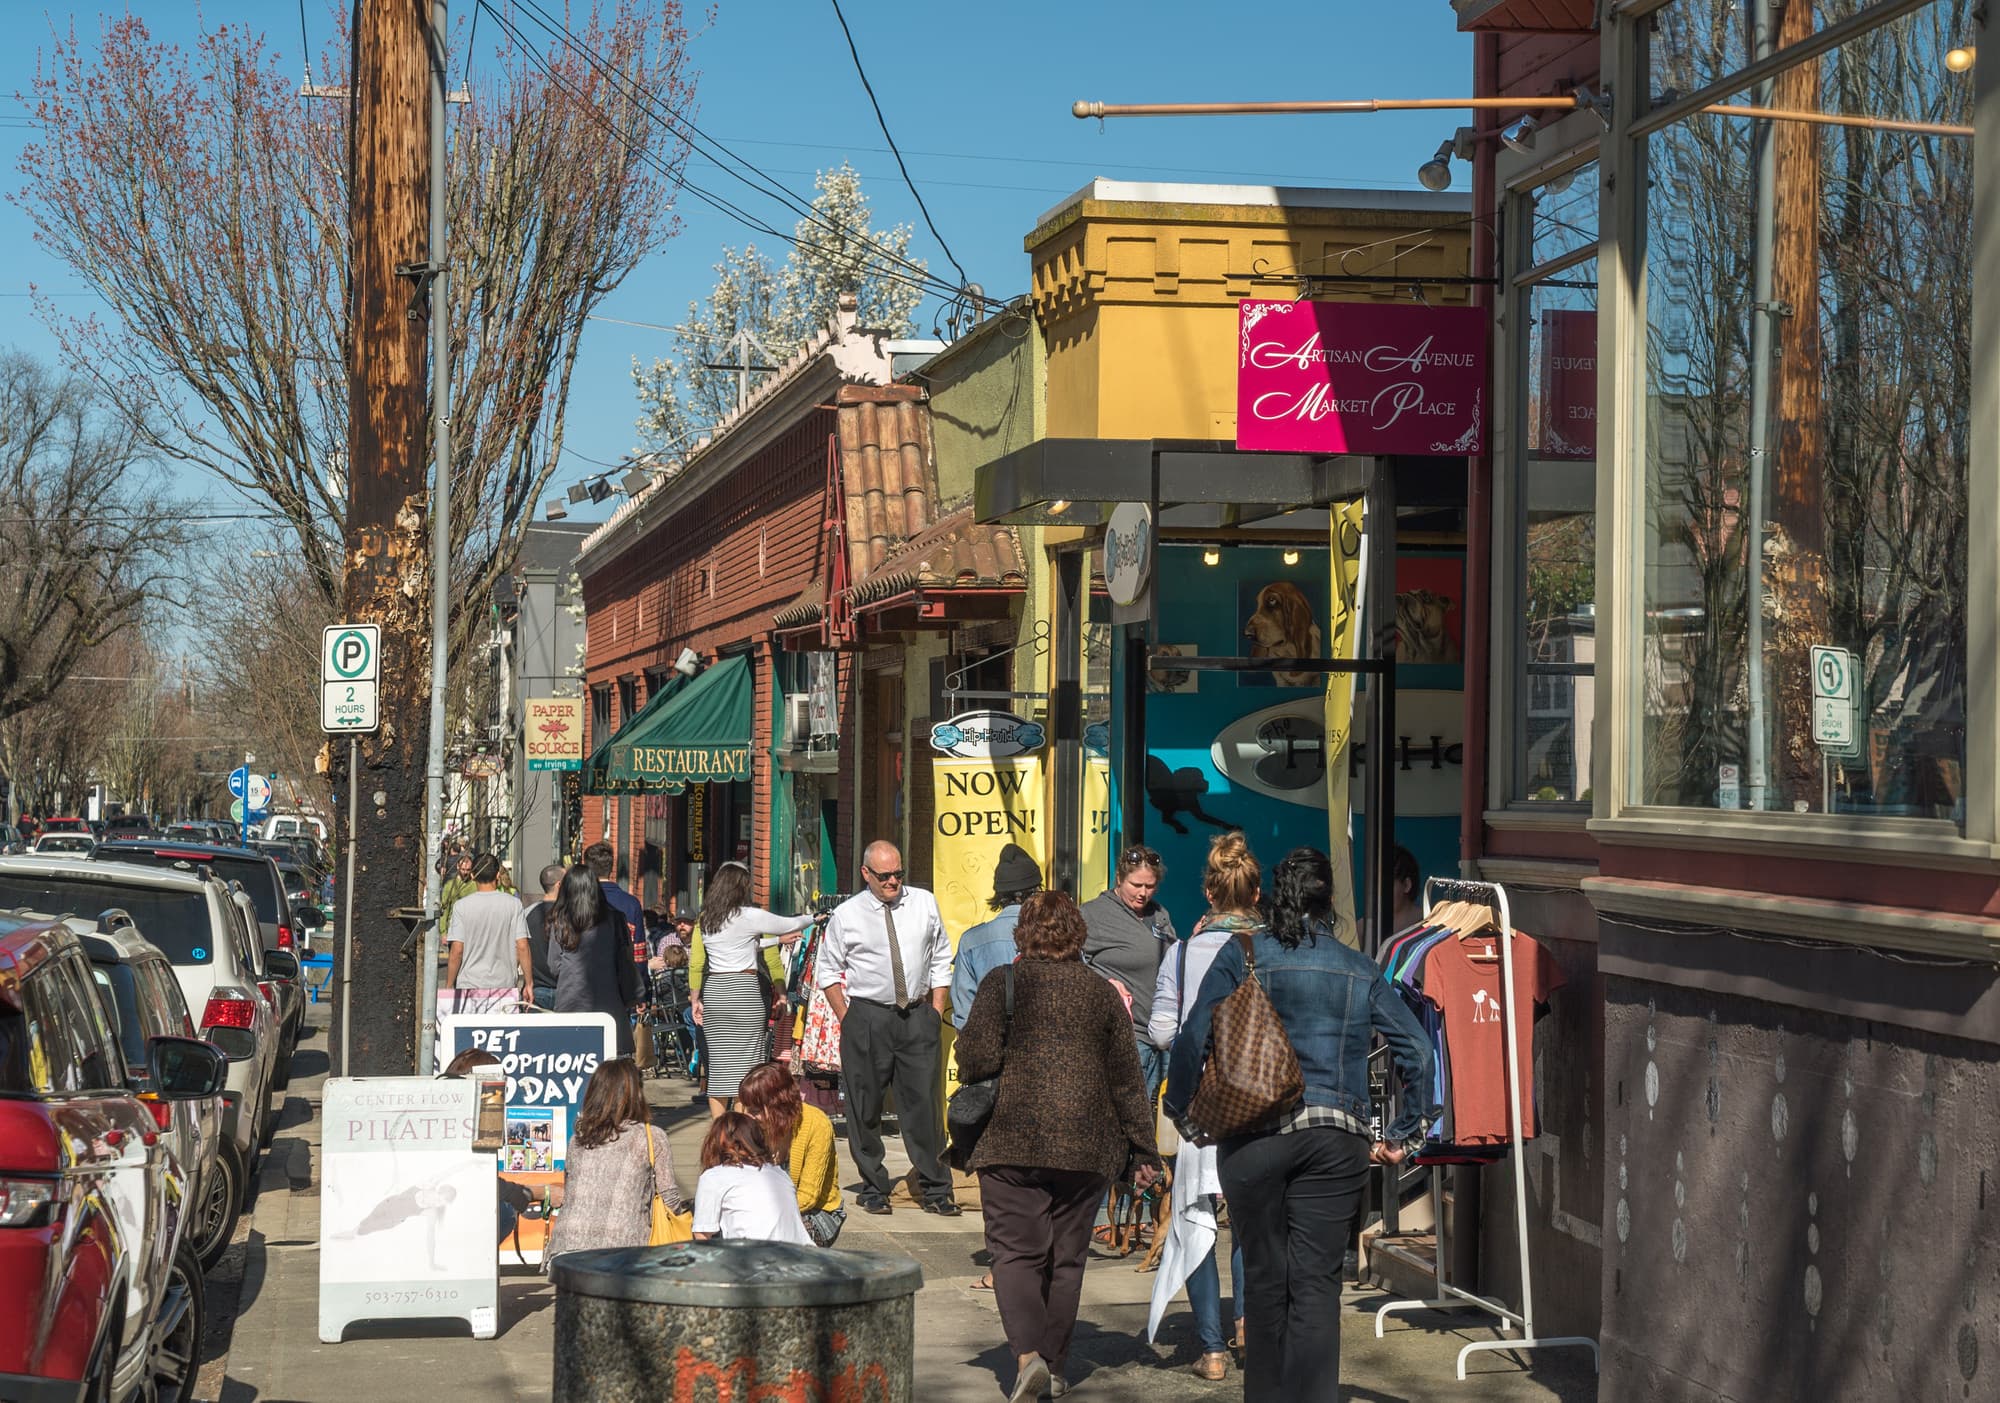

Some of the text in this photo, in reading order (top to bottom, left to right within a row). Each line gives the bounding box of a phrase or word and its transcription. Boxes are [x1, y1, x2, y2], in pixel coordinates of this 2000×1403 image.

[1250, 331, 1475, 374] ARTISAN AVENUE
[1253, 382, 1456, 430] MARKET PLACE
[343, 641, 362, 669] P
[346, 686, 355, 702] 2
[335, 704, 366, 714] HOURS
[533, 705, 575, 718] PAPER
[528, 742, 580, 755] SOURCE
[633, 748, 748, 774] RESTAURANT
[944, 770, 1028, 797] NOW
[937, 809, 1036, 837] OPEN!
[471, 1029, 521, 1052] PET
[355, 1093, 464, 1106] CENTER FLOW
[347, 1117, 476, 1142] PILATES
